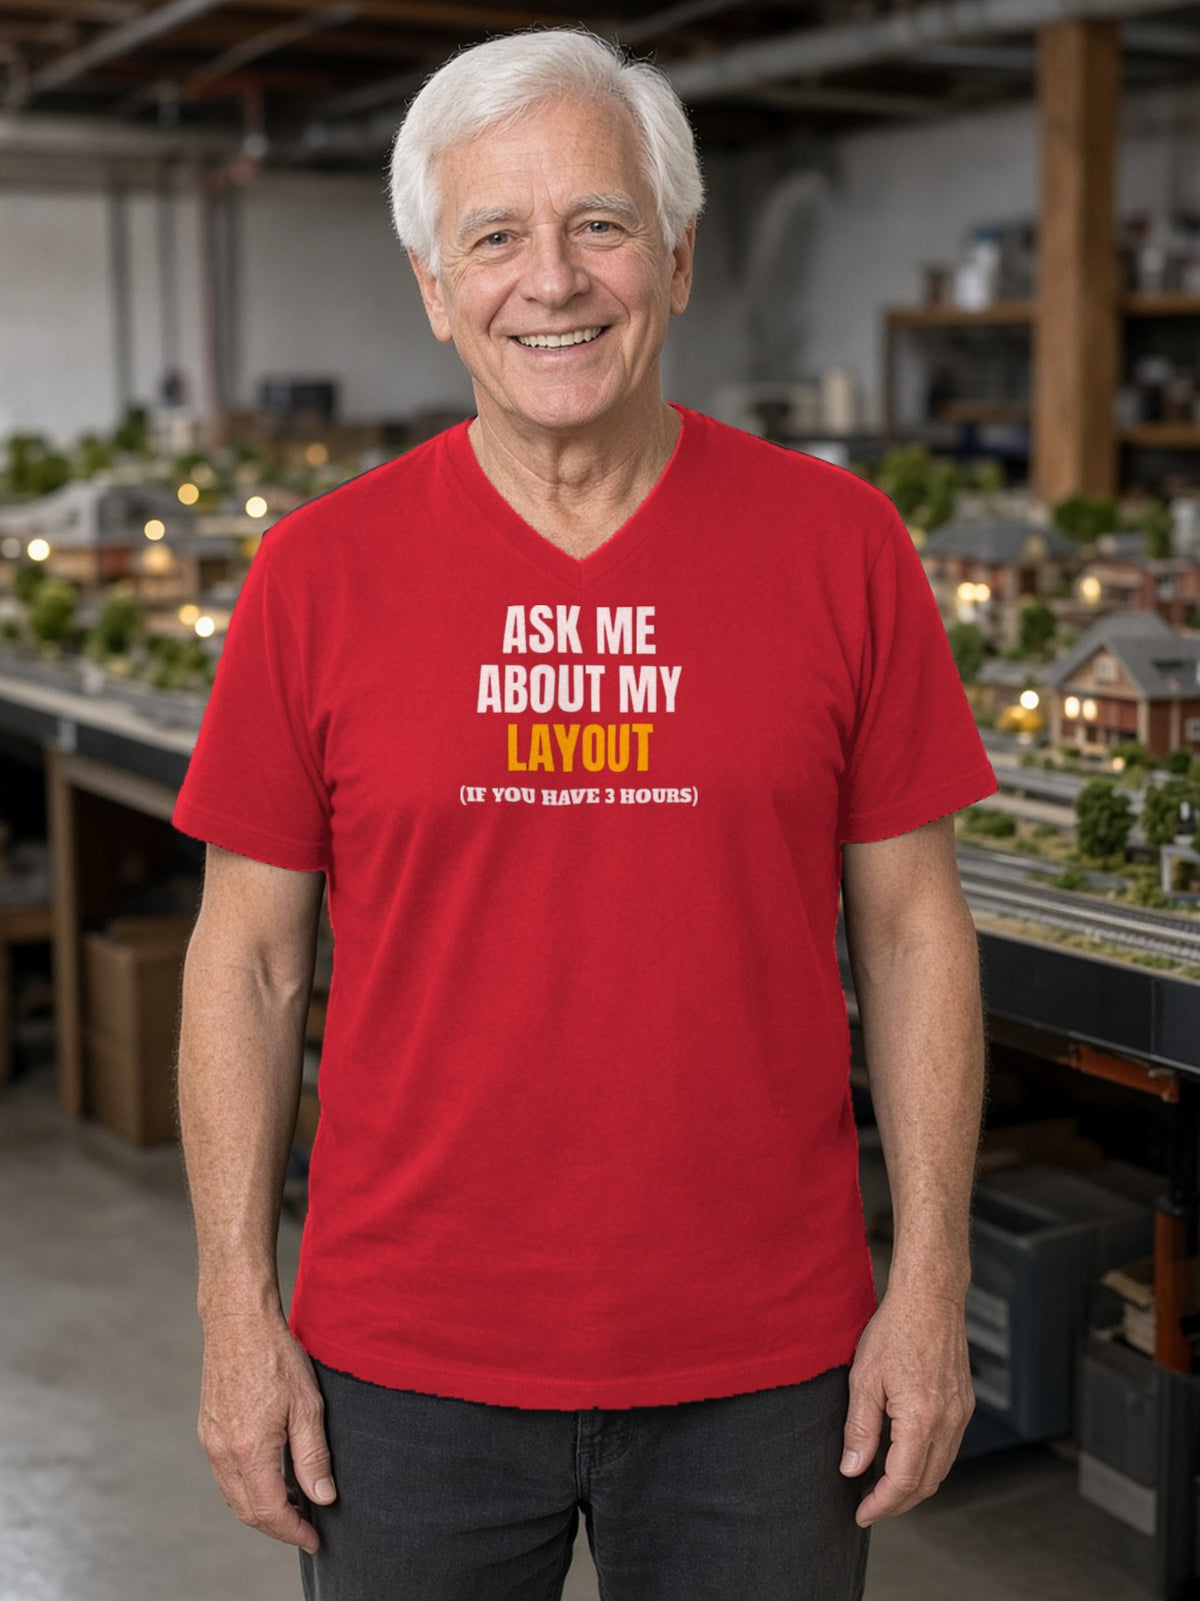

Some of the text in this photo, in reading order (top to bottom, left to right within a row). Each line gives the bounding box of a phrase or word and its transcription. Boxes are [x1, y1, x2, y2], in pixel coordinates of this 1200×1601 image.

[502, 604, 657, 655] ASK ME
[476, 663, 683, 714] ABOUT MY
[507, 723, 654, 773] LAYOUT
[459, 785, 699, 807] (IF YOU HAVE 3 HOURS)
